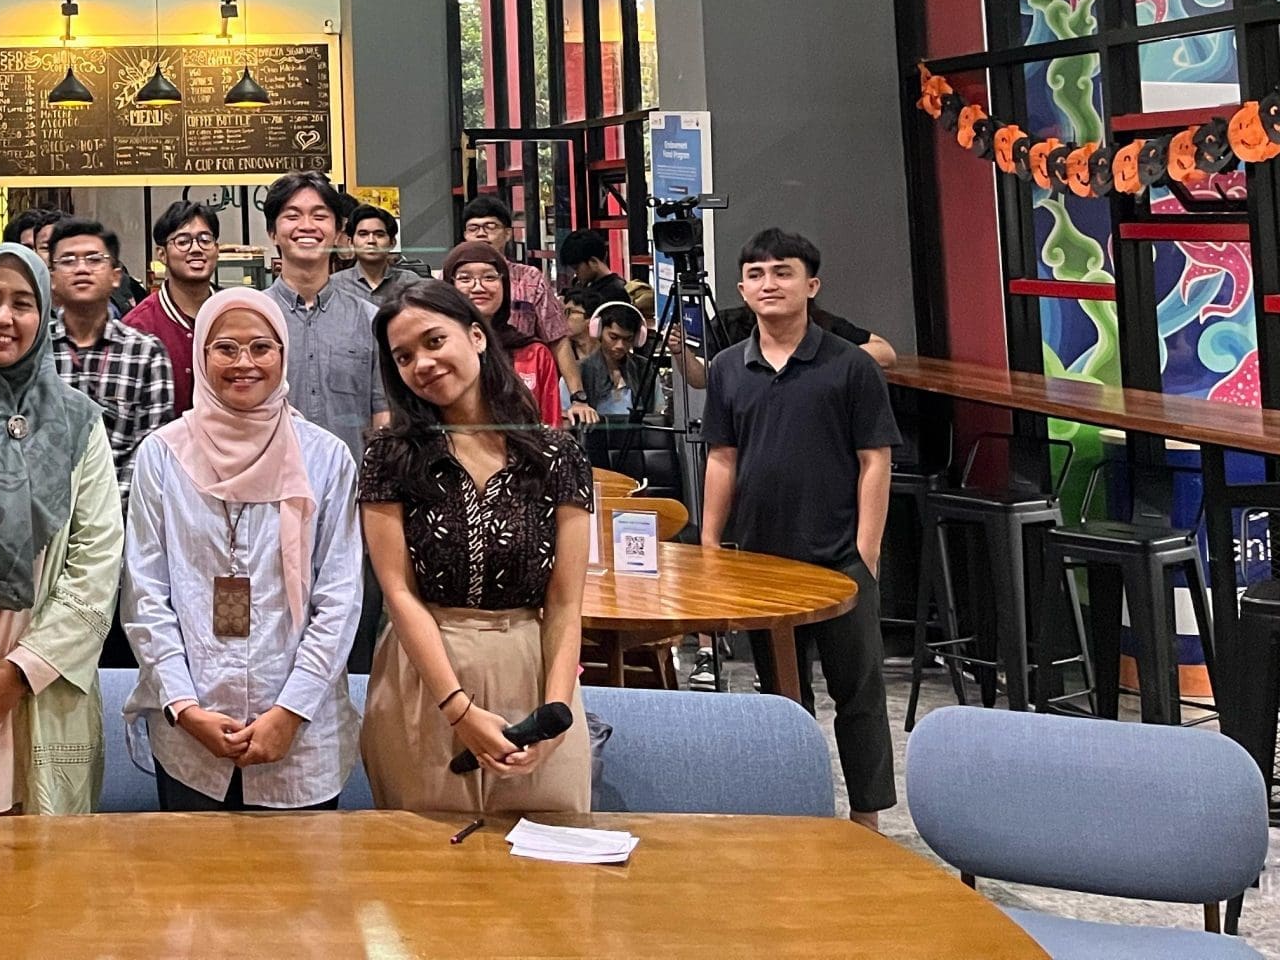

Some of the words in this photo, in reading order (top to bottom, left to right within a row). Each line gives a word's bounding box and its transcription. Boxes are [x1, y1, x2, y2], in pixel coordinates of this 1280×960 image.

[184, 158, 192, 171] A
[195, 158, 214, 171] CUP
[216, 157, 235, 171] FOR
[238, 156, 304, 171] ENDOWMENT
